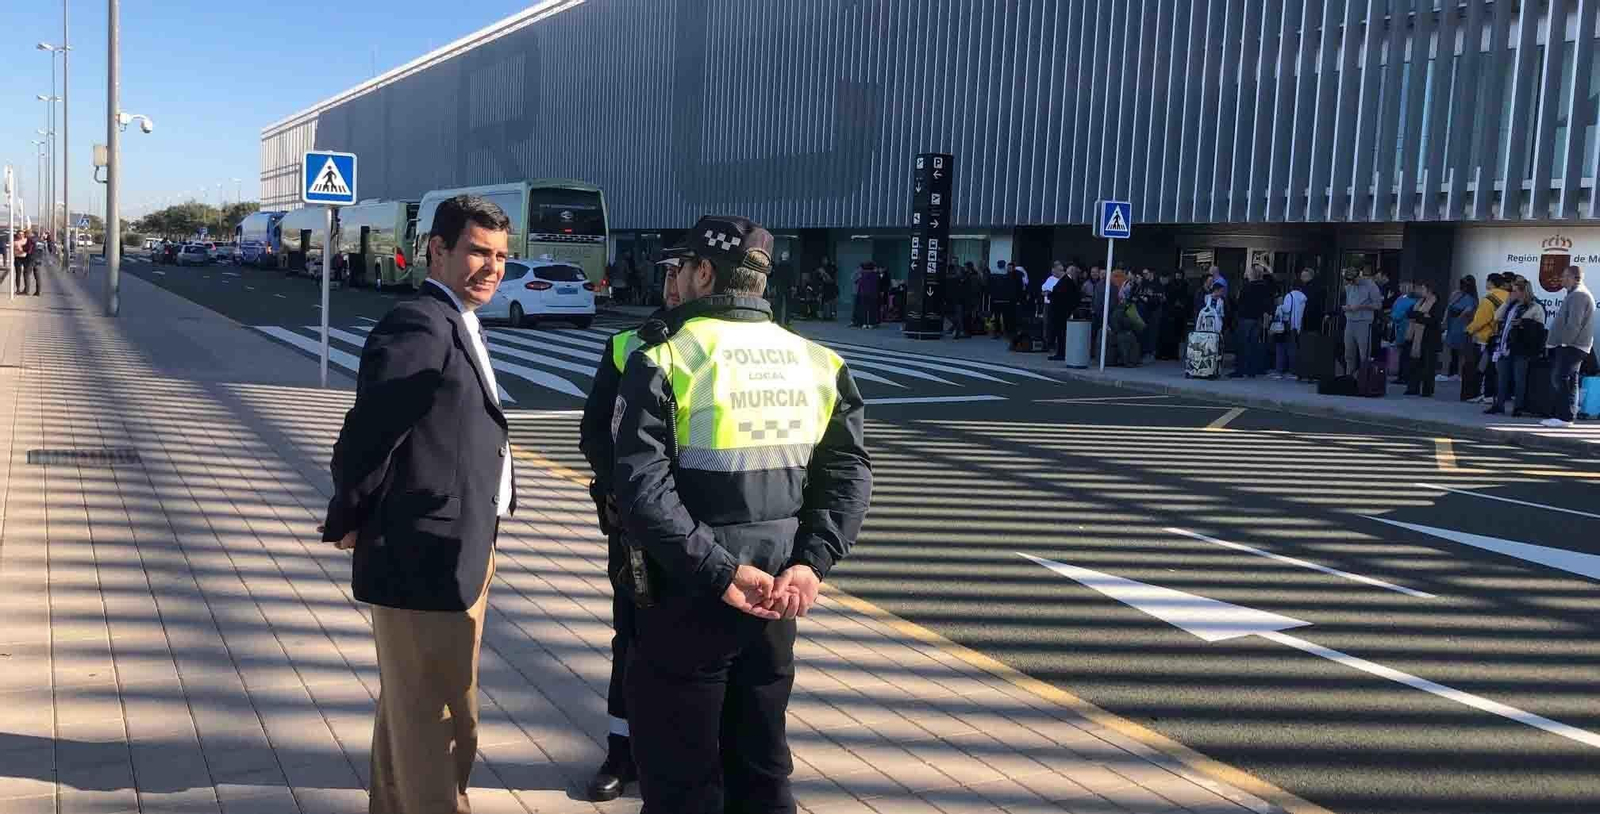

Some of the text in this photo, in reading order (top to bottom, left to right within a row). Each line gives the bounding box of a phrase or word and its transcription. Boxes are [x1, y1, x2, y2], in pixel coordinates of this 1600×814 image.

[1507, 254, 1538, 263] Región
[1574, 255, 1585, 263] de
[748, 371, 787, 381] LOCAL
[729, 388, 809, 410] MURCIA
